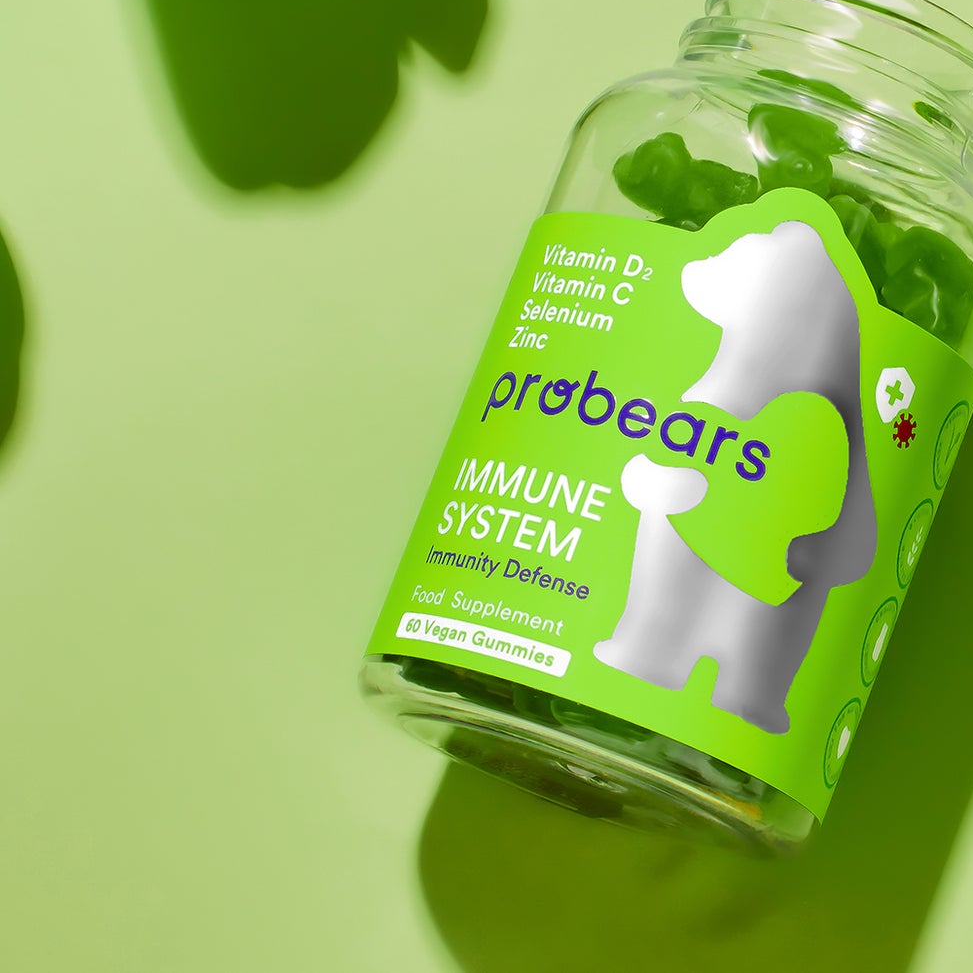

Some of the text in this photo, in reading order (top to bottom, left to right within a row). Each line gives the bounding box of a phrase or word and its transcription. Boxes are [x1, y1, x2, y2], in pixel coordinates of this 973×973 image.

[543, 244, 616, 273] Vitamin
[532, 271, 634, 305] Vitamin C
[508, 326, 548, 350] Zinc
[520, 299, 614, 331] Selenium
[481, 370, 771, 481] probears
[453, 457, 612, 521] IMMUNE
[437, 500, 582, 562] SYSTEM
[425, 544, 590, 600] Immunity Defense
[411, 584, 564, 637] Food Supplement
[405, 618, 555, 668] 60 Vegan Gummies
